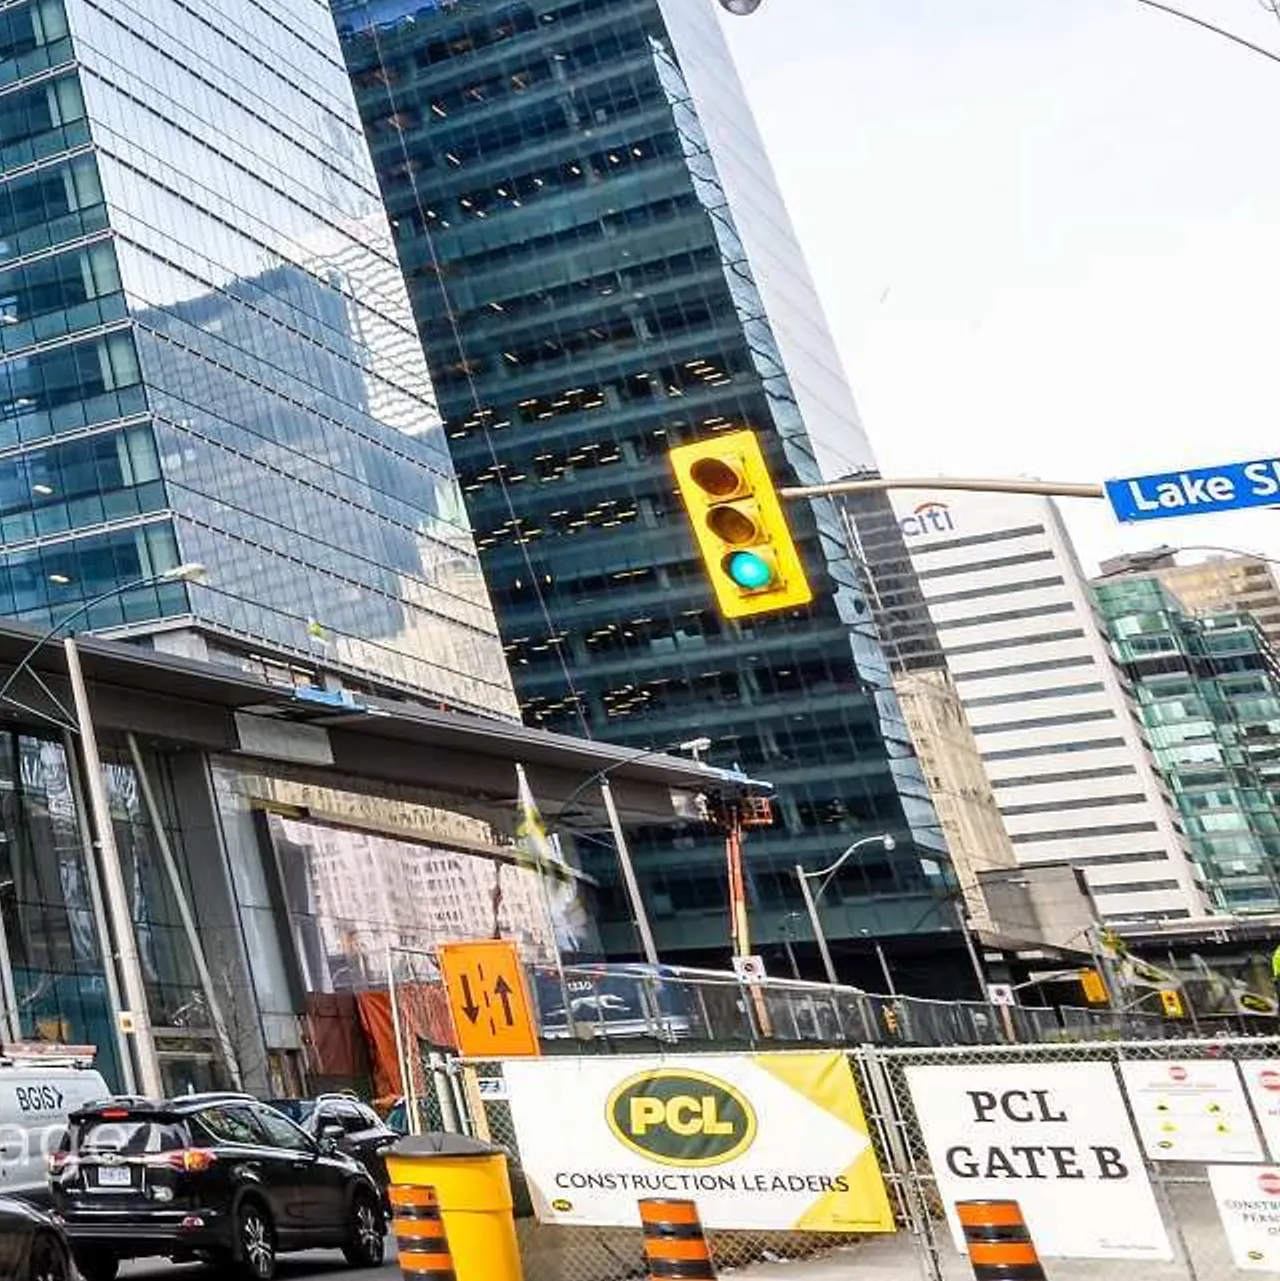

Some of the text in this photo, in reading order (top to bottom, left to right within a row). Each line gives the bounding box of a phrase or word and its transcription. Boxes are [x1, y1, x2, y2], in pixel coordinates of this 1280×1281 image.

[1128, 474, 1236, 511] Lake
[900, 505, 954, 536] citi
[16, 1085, 56, 1111] BGIS
[966, 1089, 1068, 1123] PCL
[629, 1095, 736, 1136] PCL
[945, 1145, 1130, 1180] GATE B
[555, 1172, 850, 1193] CONSTRUCTION LEADERS
